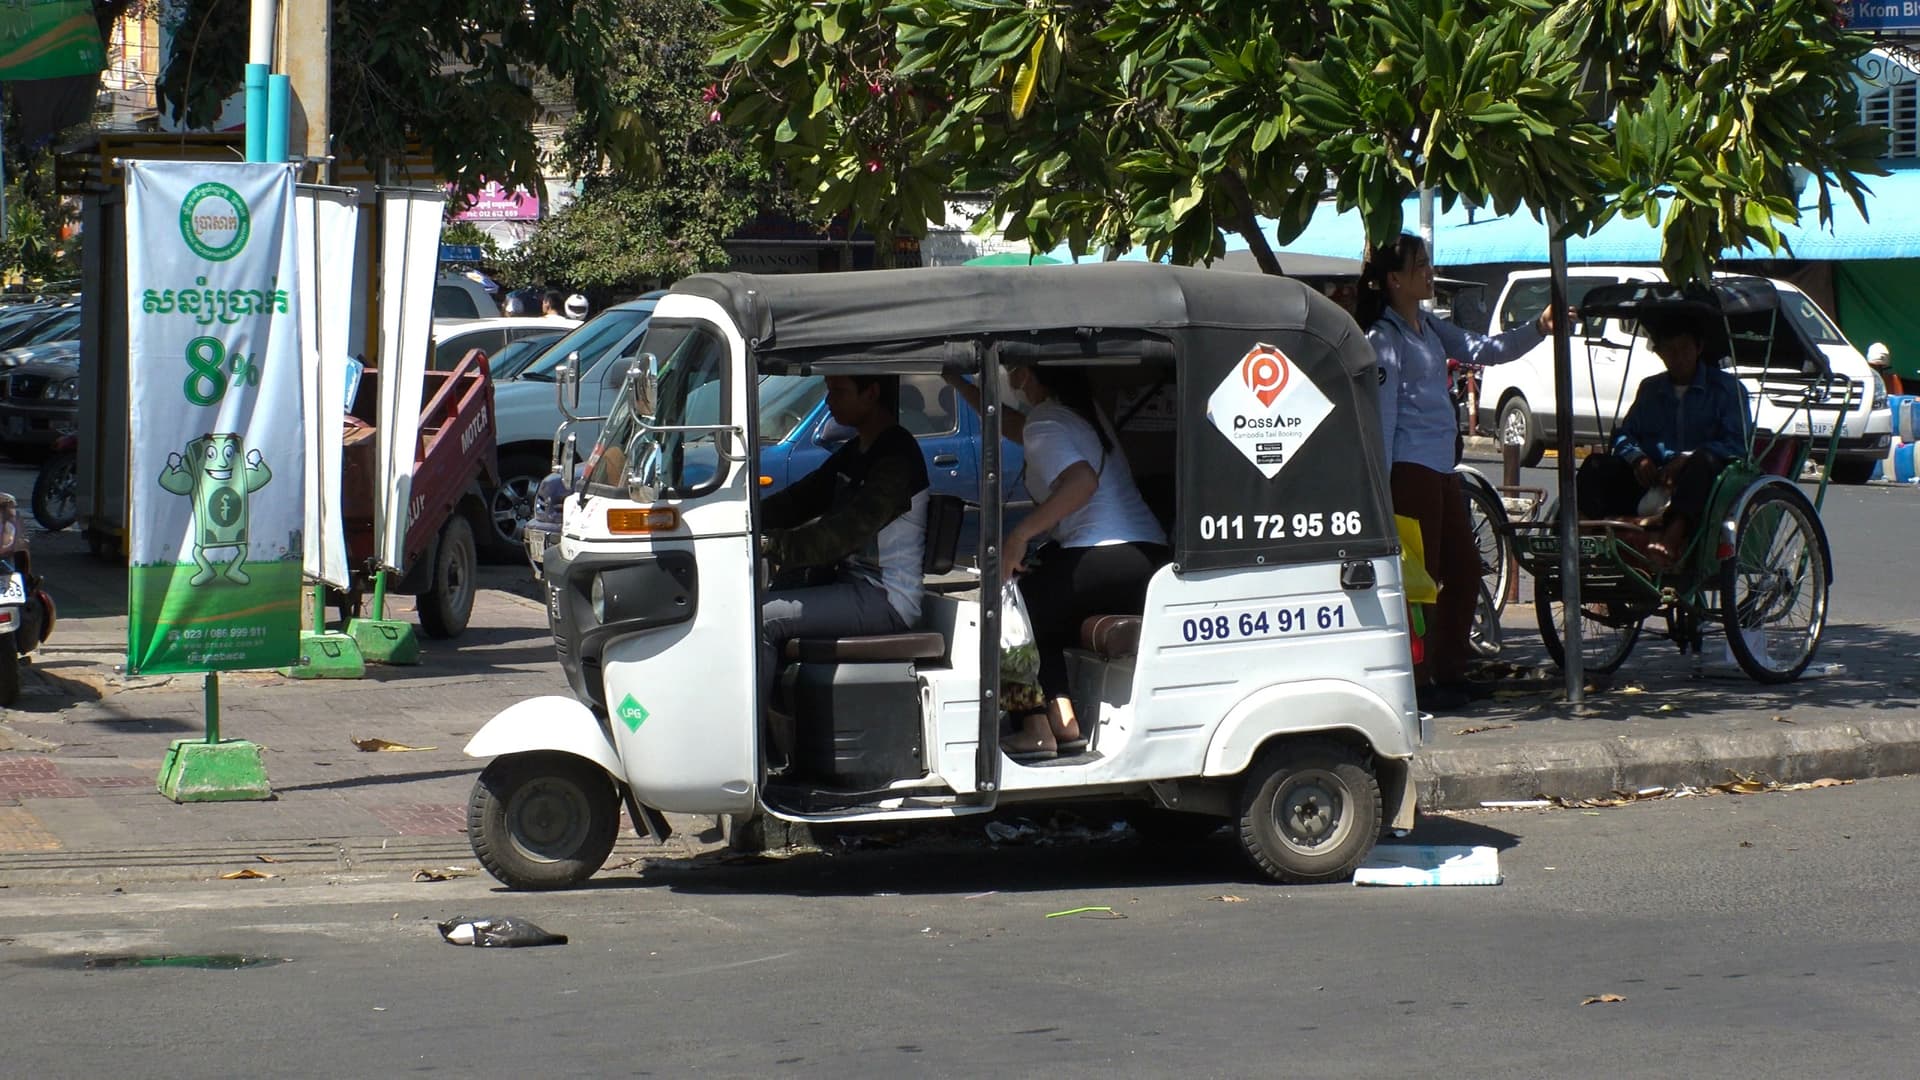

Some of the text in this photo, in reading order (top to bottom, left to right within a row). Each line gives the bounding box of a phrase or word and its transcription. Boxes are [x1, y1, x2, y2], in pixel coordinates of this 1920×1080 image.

[1860, 2, 1899, 17] Krom
[733, 254, 810, 266] OMANSON
[143, 276, 289, 325] សន្សំប្រាក់
[183, 335, 260, 407] 8%
[1233, 431, 1264, 439] Cambodia
[1278, 430, 1303, 438] Booking
[406, 494, 425, 531] LUY
[1200, 511, 1362, 540] 011 72 95 86
[183, 629, 202, 639] 023
[1183, 605, 1345, 642] 098 64 91 61
[622, 707, 641, 719] LPG
